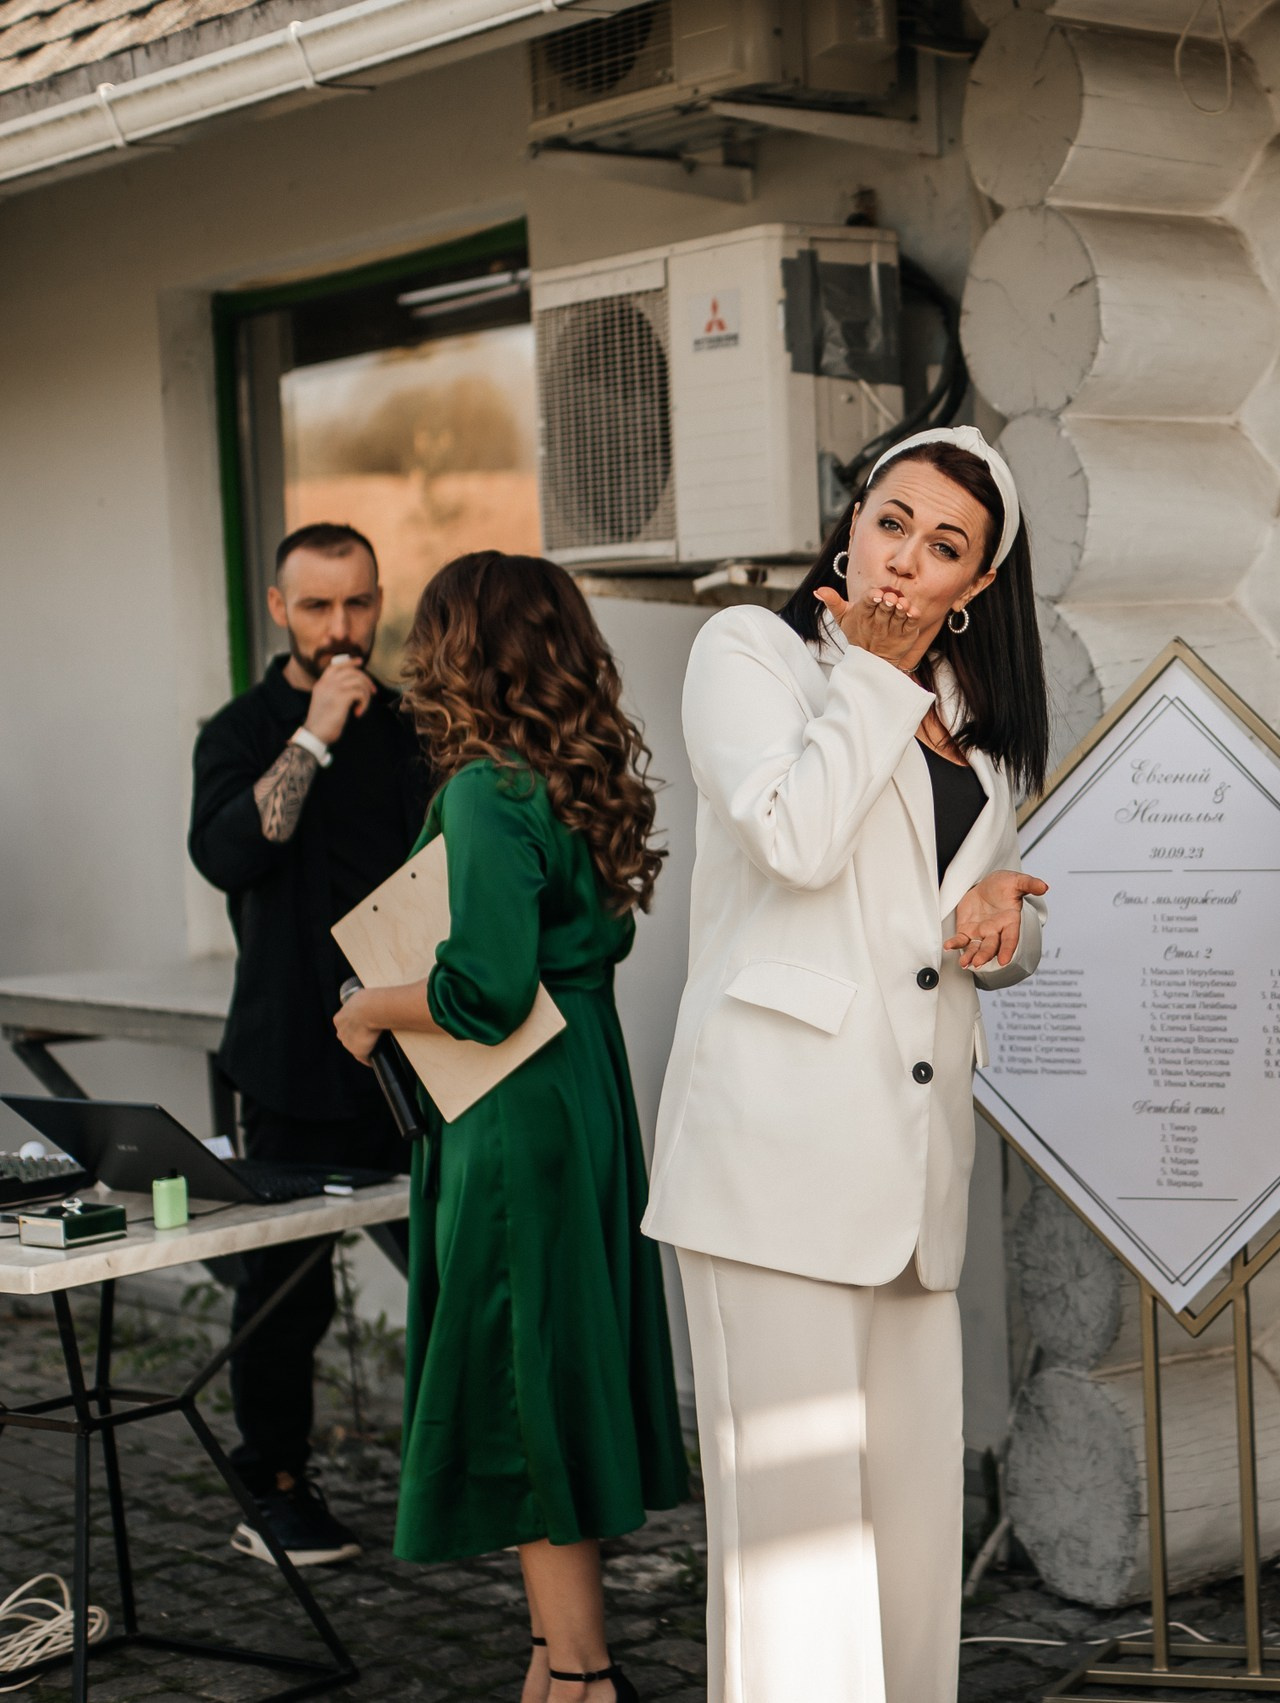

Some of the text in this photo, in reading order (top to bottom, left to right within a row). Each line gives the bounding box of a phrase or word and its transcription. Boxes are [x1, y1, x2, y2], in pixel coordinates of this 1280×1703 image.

[1130, 759, 1211, 784] Евгений
[1212, 781, 1231, 804] &
[1114, 799, 1225, 824] Наталья
[1149, 847, 1205, 859] 30.09.23
[1112, 889, 1148, 907] Стол
[1163, 944, 1213, 960] Стол 2
[1194, 1104, 1226, 1115] стол
